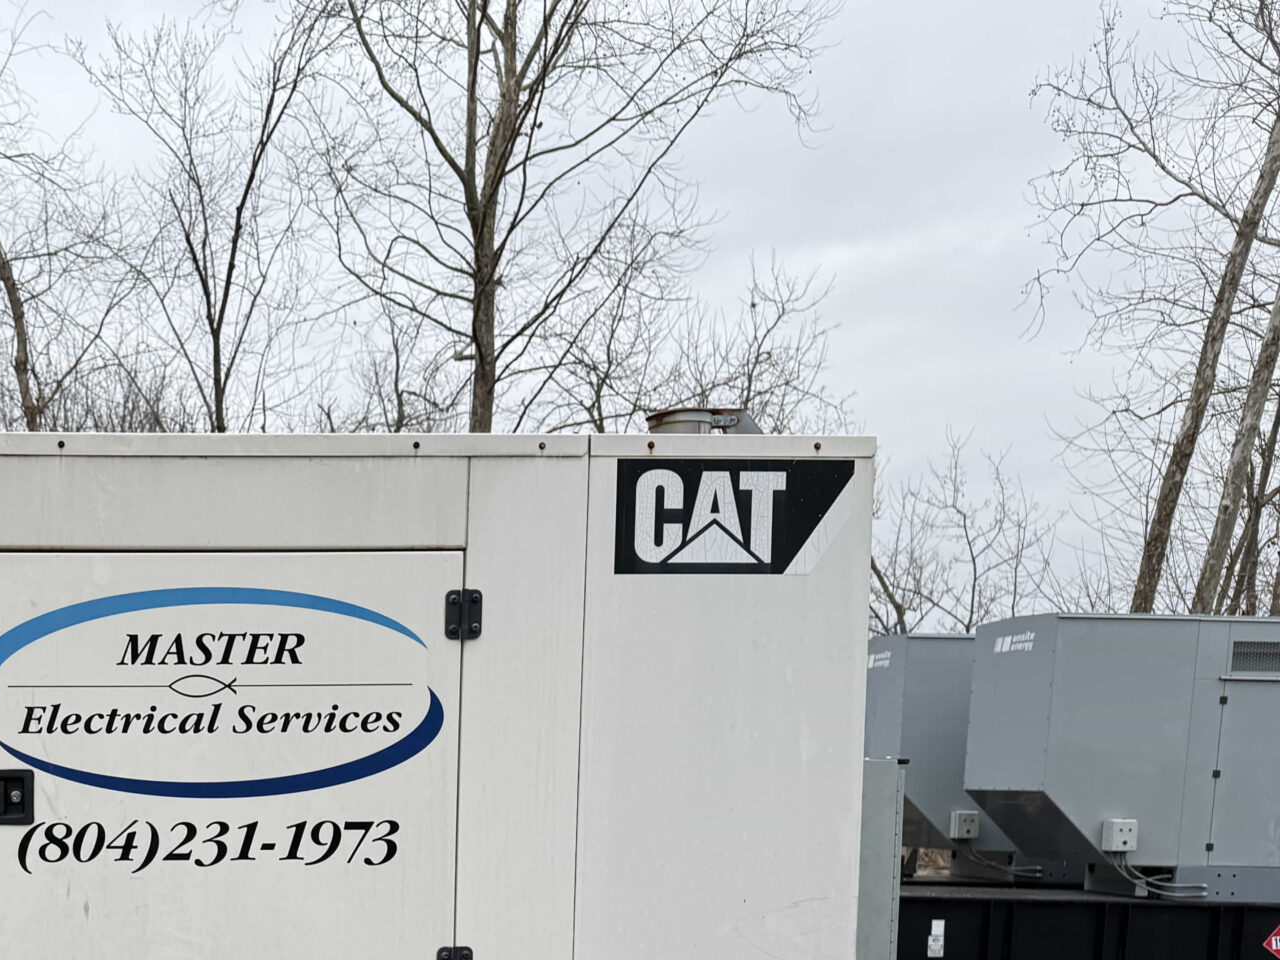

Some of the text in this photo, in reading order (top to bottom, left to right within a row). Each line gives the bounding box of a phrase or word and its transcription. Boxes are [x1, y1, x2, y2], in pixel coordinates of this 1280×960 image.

[634, 469, 787, 564] CAT
[117, 632, 305, 665] MASTER
[1011, 641, 1033, 651] energy
[1012, 631, 1035, 642] onsite
[18, 703, 402, 734] Electrical Services
[17, 819, 401, 874] (804)231-1973
